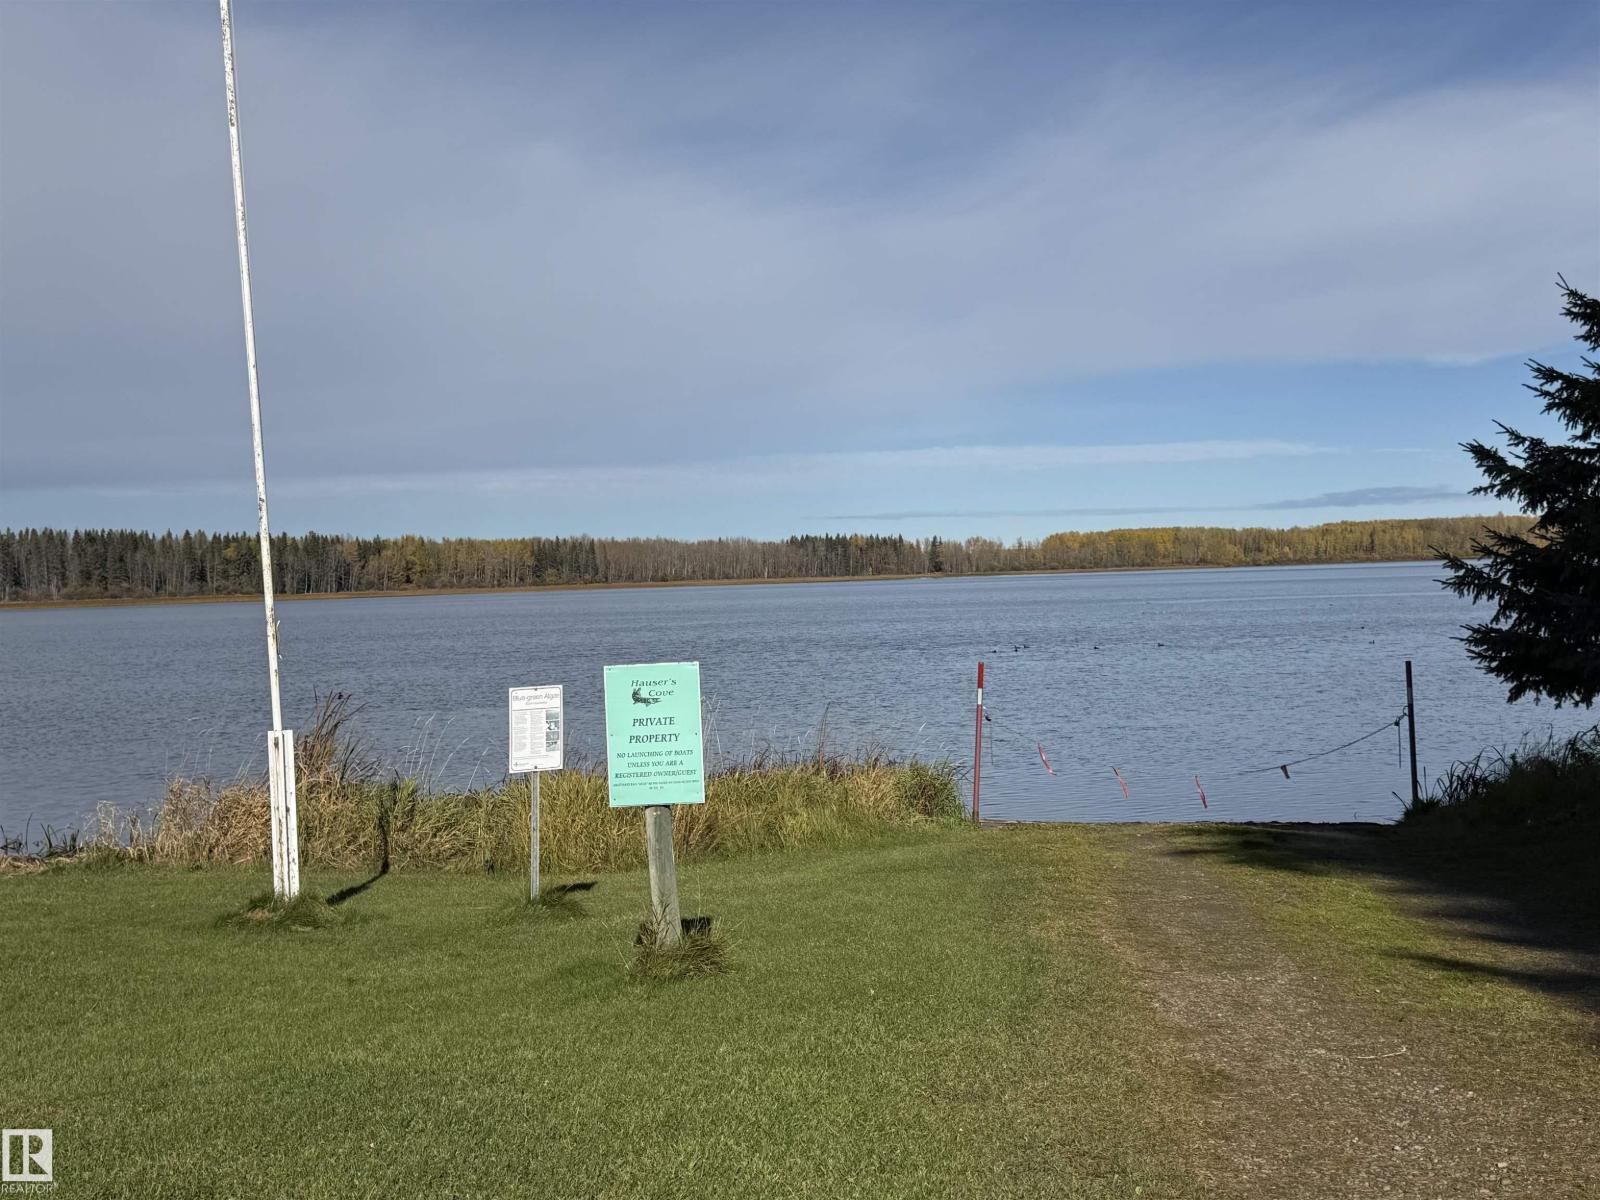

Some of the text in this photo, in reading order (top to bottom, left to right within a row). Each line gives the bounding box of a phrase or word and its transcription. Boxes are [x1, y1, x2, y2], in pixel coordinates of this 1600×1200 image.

[630, 678, 677, 687] Hauser's
[648, 689, 675, 697] Cove
[632, 716, 676, 727] PRIVATE
[629, 733, 680, 744] PROPERTY
[615, 771, 653, 779] REGISTERED
